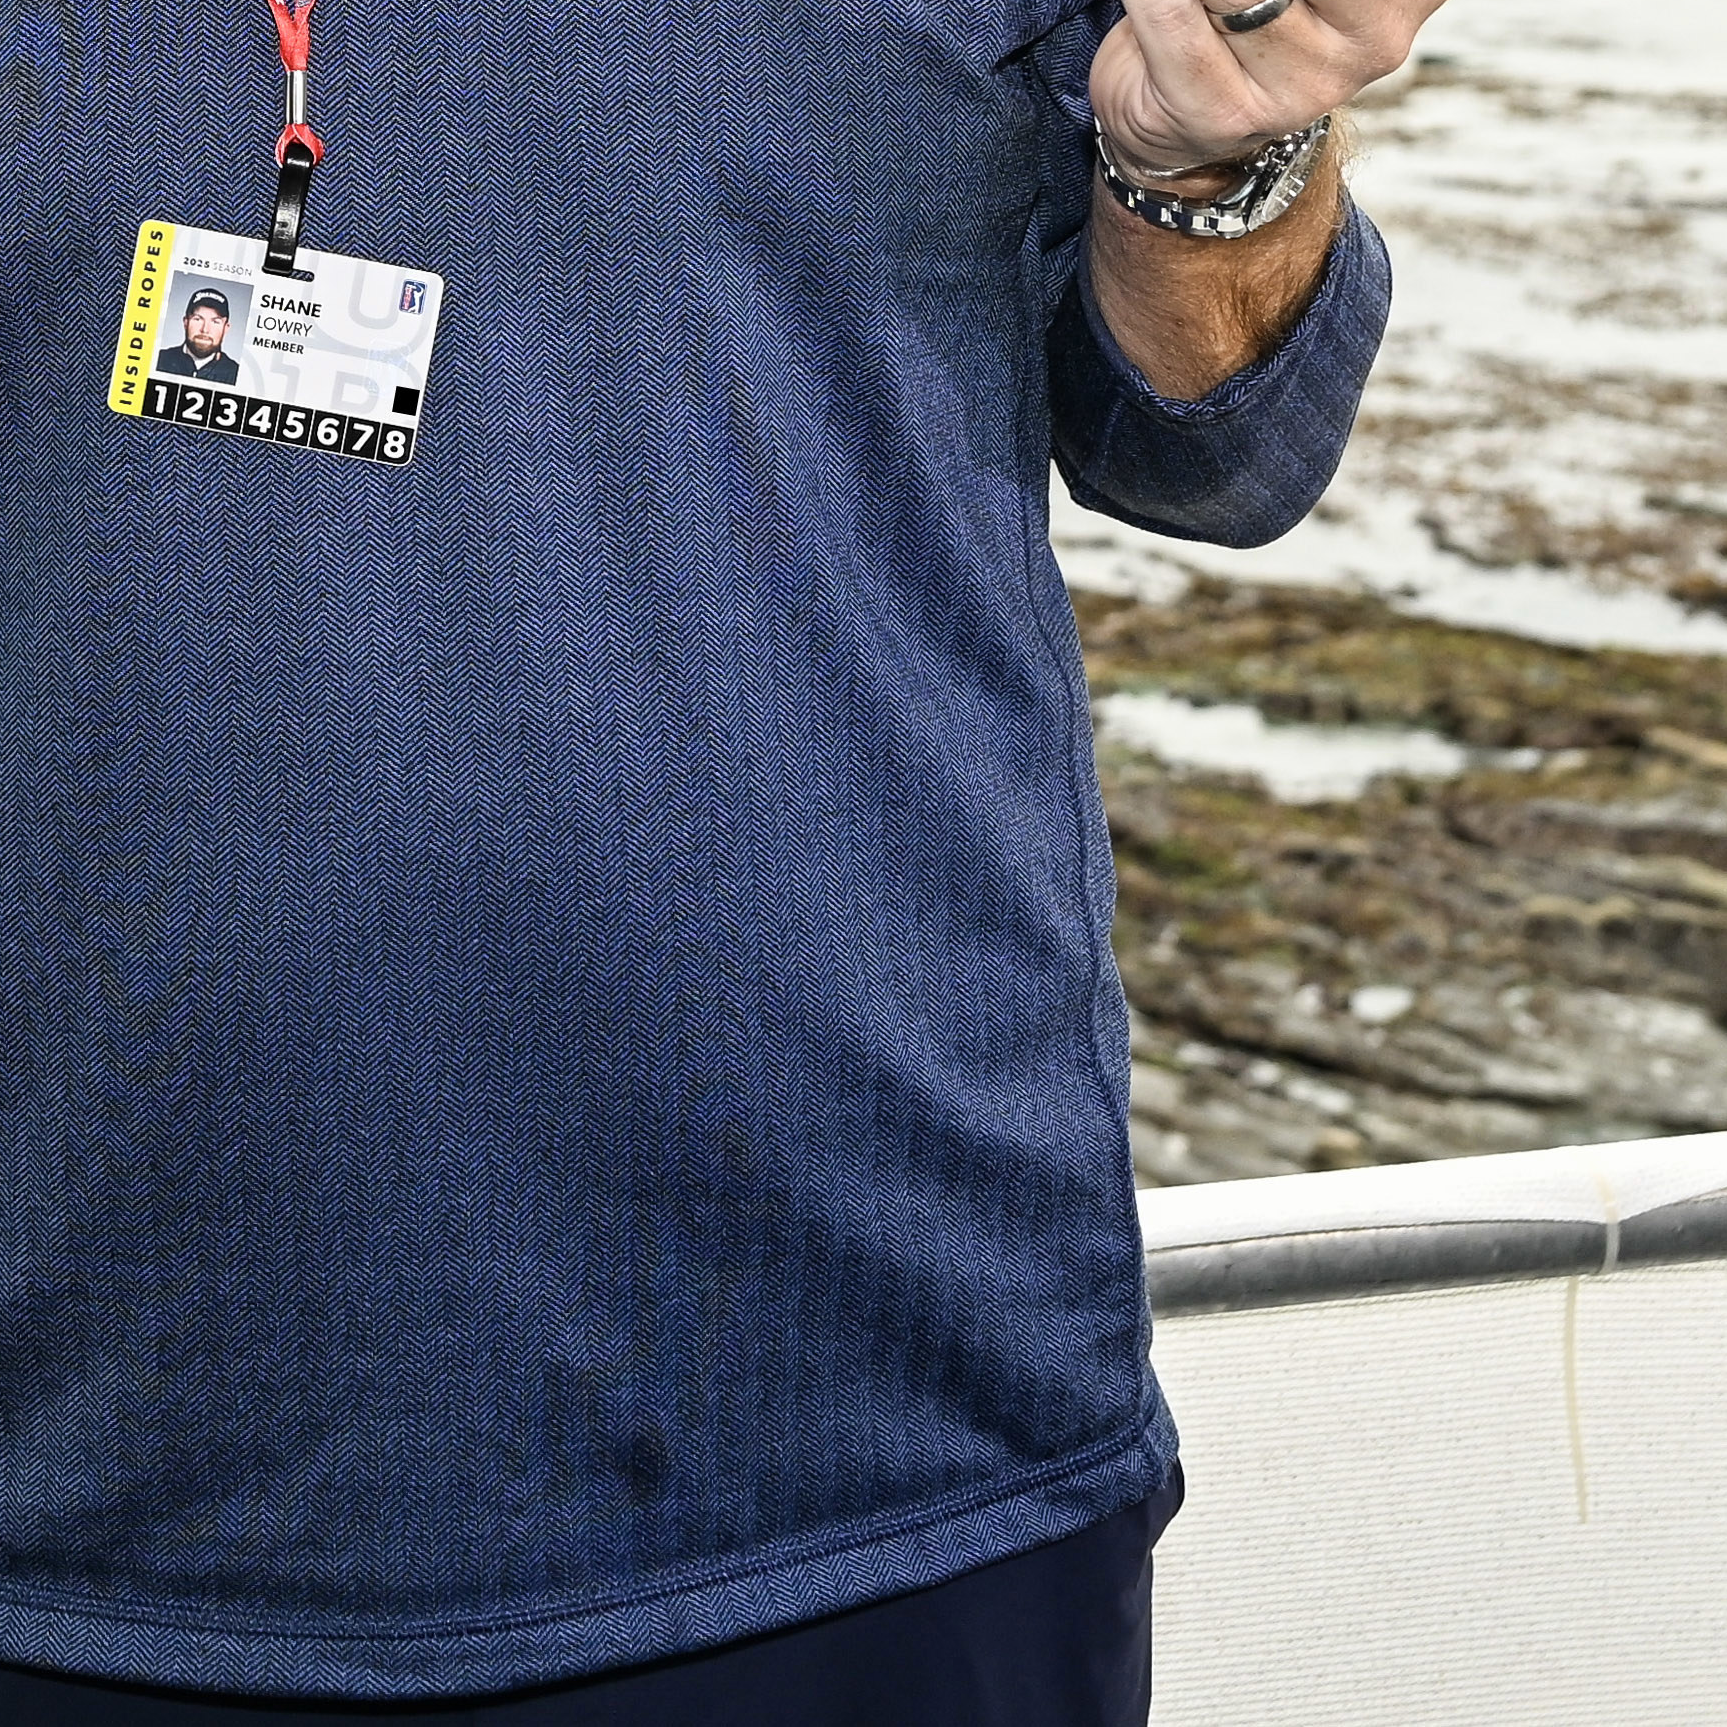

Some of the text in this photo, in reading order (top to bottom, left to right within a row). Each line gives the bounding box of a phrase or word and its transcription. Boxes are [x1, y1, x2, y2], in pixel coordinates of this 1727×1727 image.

[183, 256, 253, 277] 2025 SEASON
[119, 230, 163, 406] INSIDE ROPES
[260, 294, 322, 318] SHANE
[256, 314, 314, 338] LOWRY
[252, 337, 305, 355] MEMBER
[154, 385, 406, 459] 1 2 3 4 5 6 7 8
